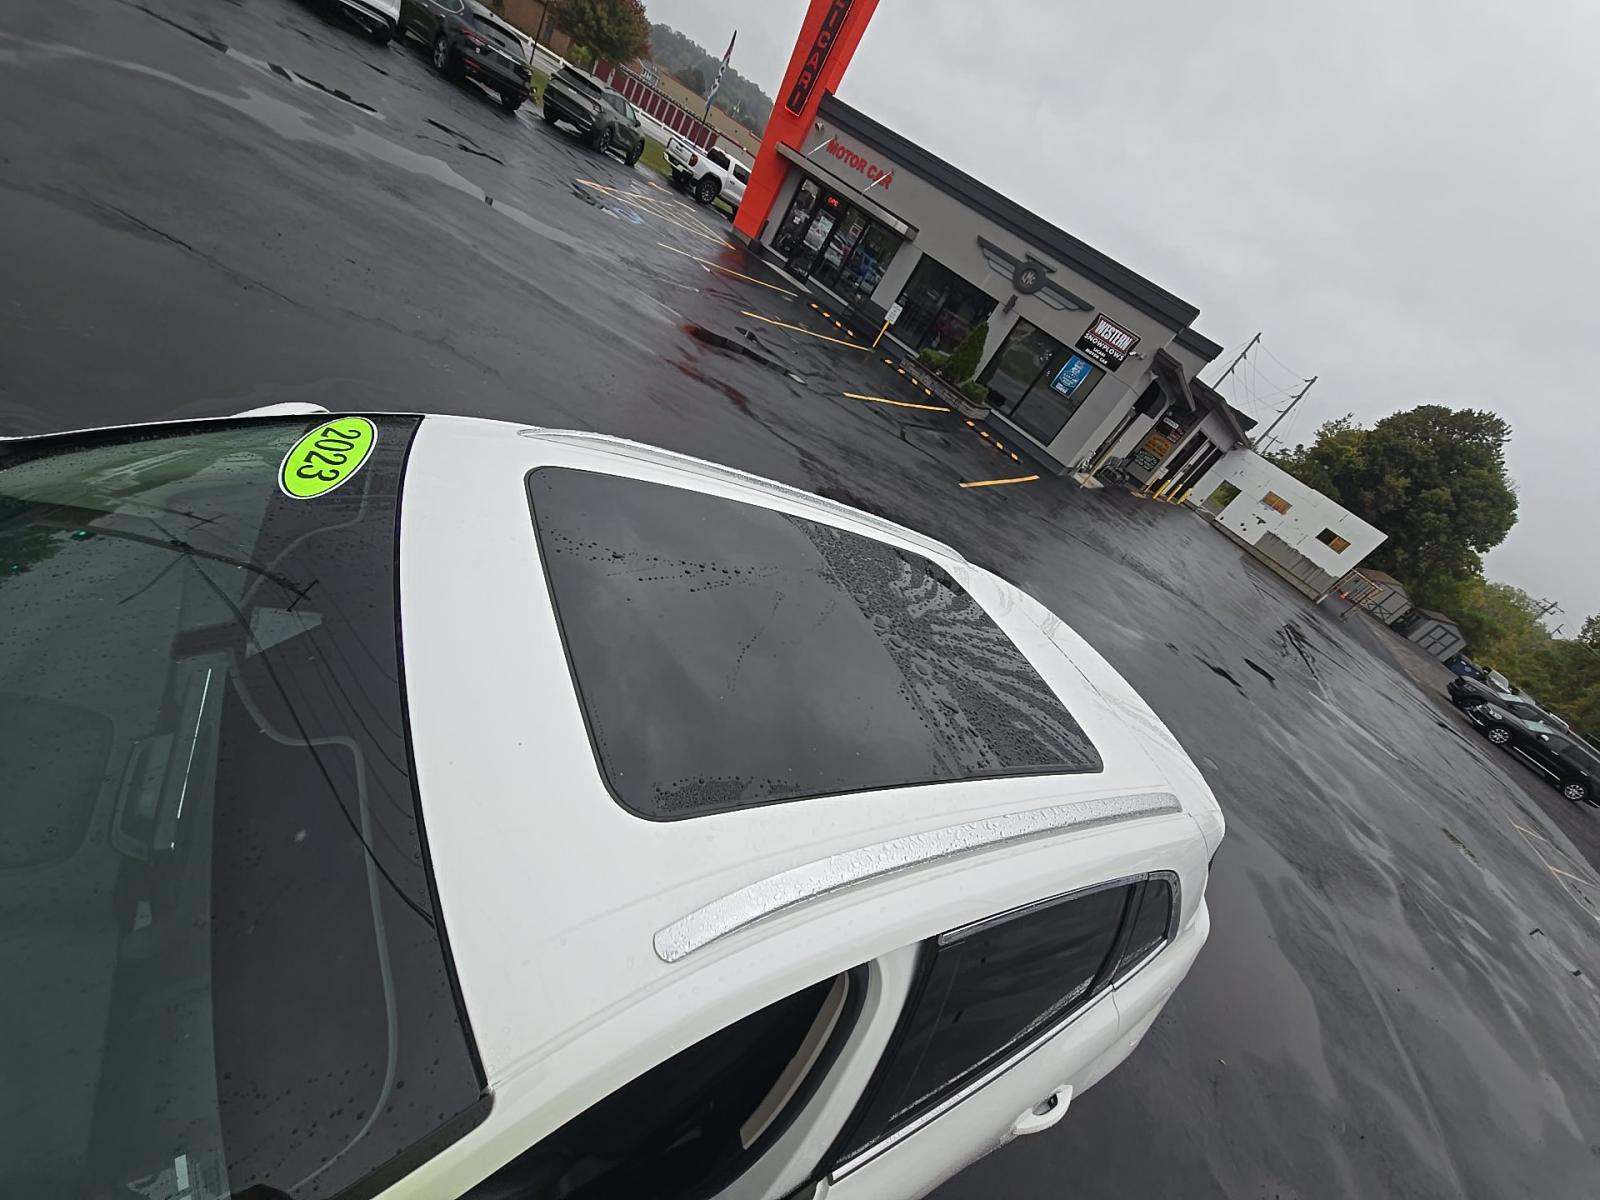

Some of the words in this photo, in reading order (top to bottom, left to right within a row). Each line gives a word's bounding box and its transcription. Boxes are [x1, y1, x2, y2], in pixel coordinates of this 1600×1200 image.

[826, 139, 868, 173] MOTOR
[866, 164, 894, 190] CAR
[1084, 333, 1124, 361] SNOWPLOWS
[1094, 320, 1133, 351] WESTERN
[297, 427, 361, 481] 2023
